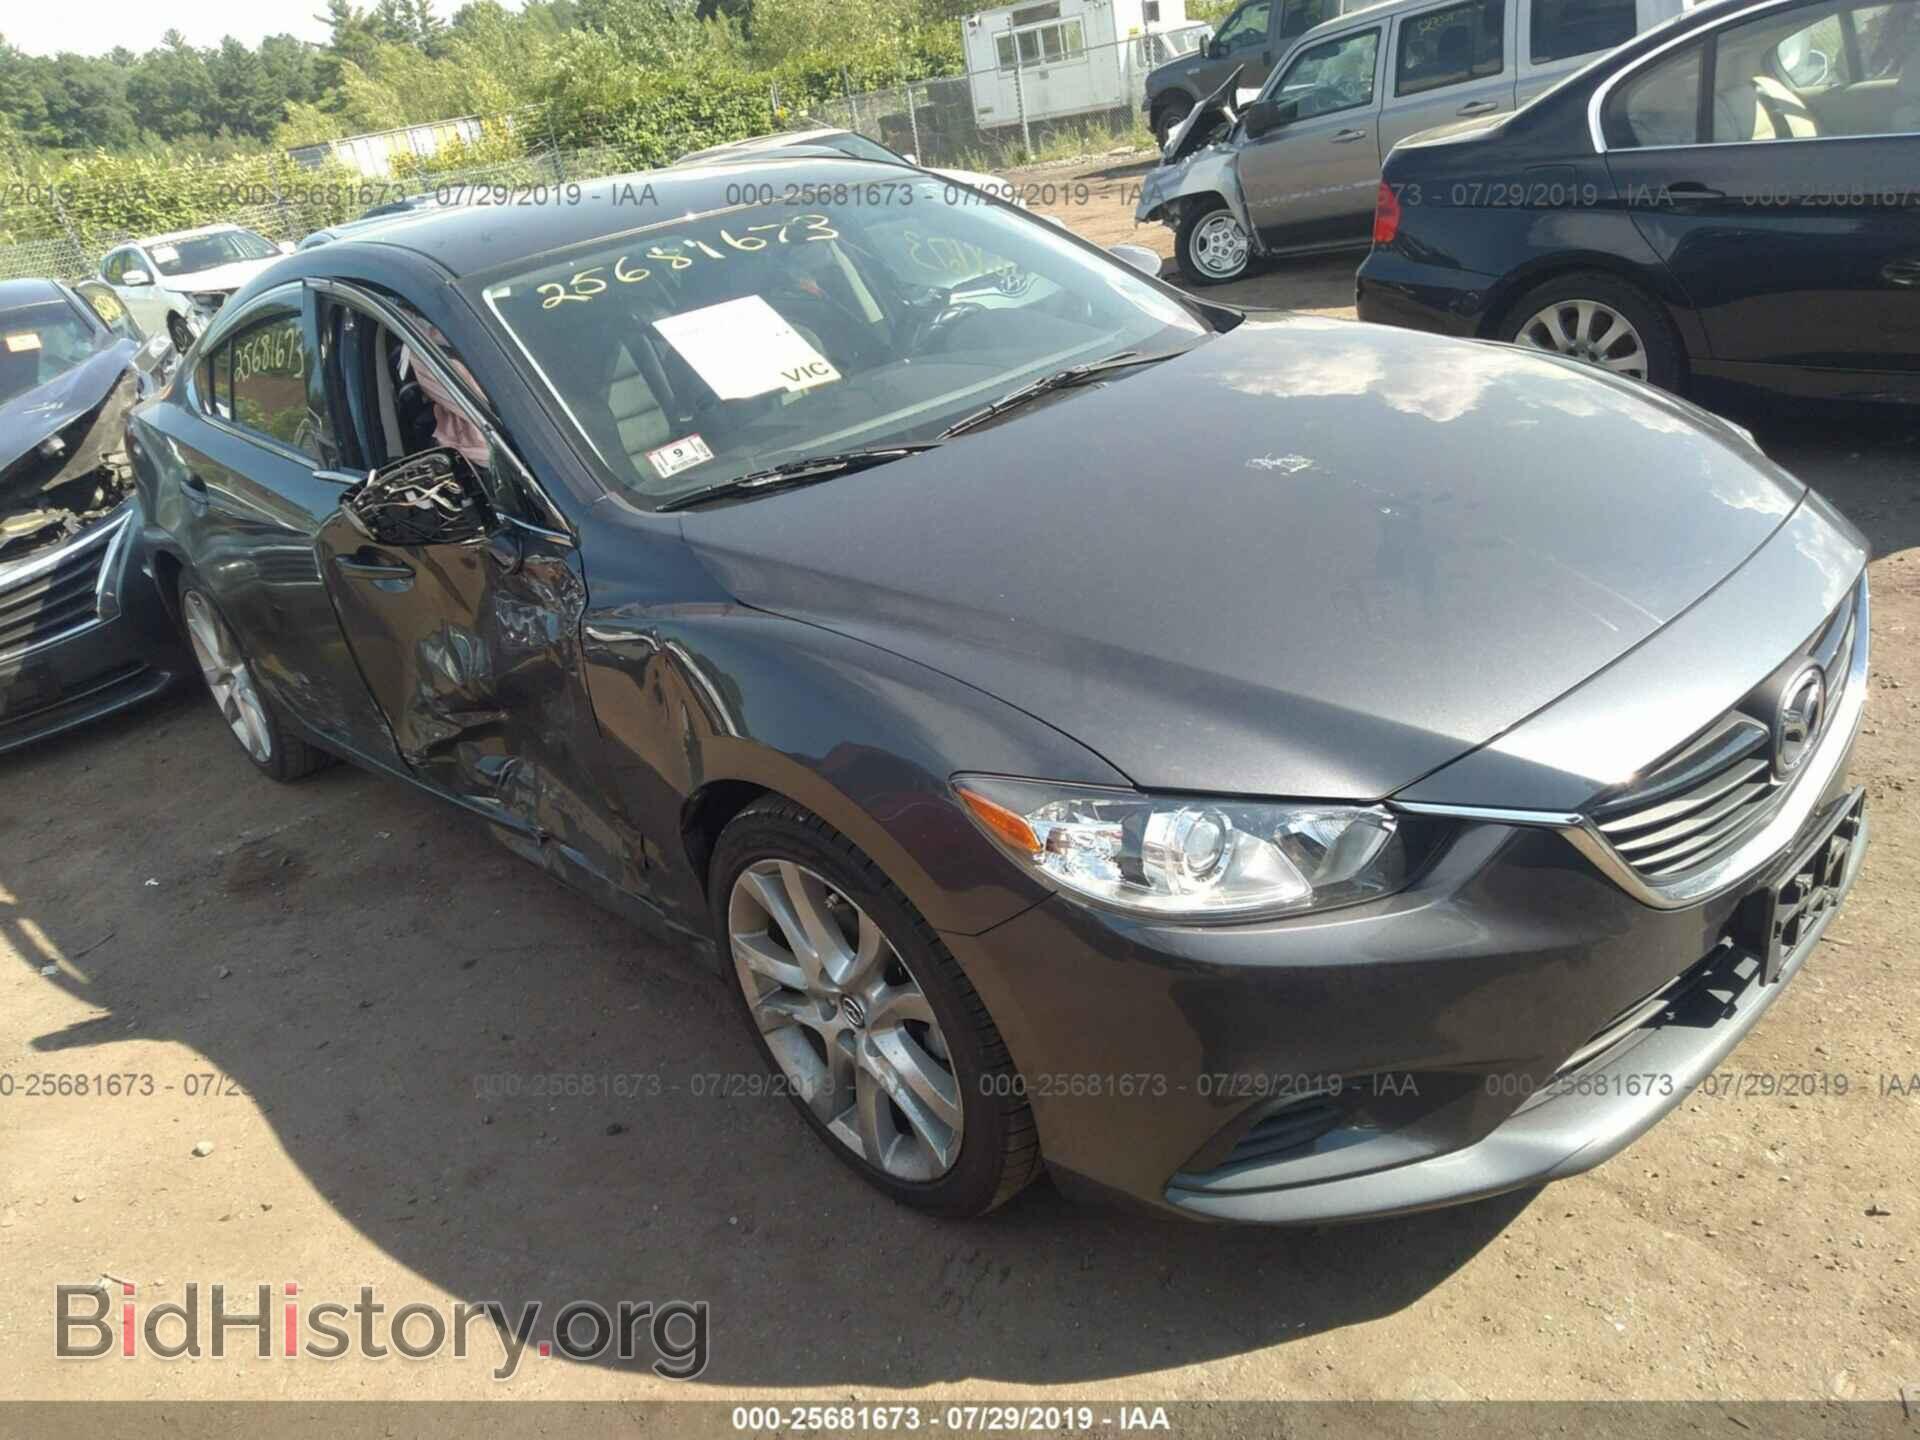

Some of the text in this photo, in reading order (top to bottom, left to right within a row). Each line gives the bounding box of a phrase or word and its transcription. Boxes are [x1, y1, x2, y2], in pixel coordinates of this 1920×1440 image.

[233, 327, 305, 382] 25681673
[781, 361, 830, 383] VIC
[672, 448, 684, 458] 9
